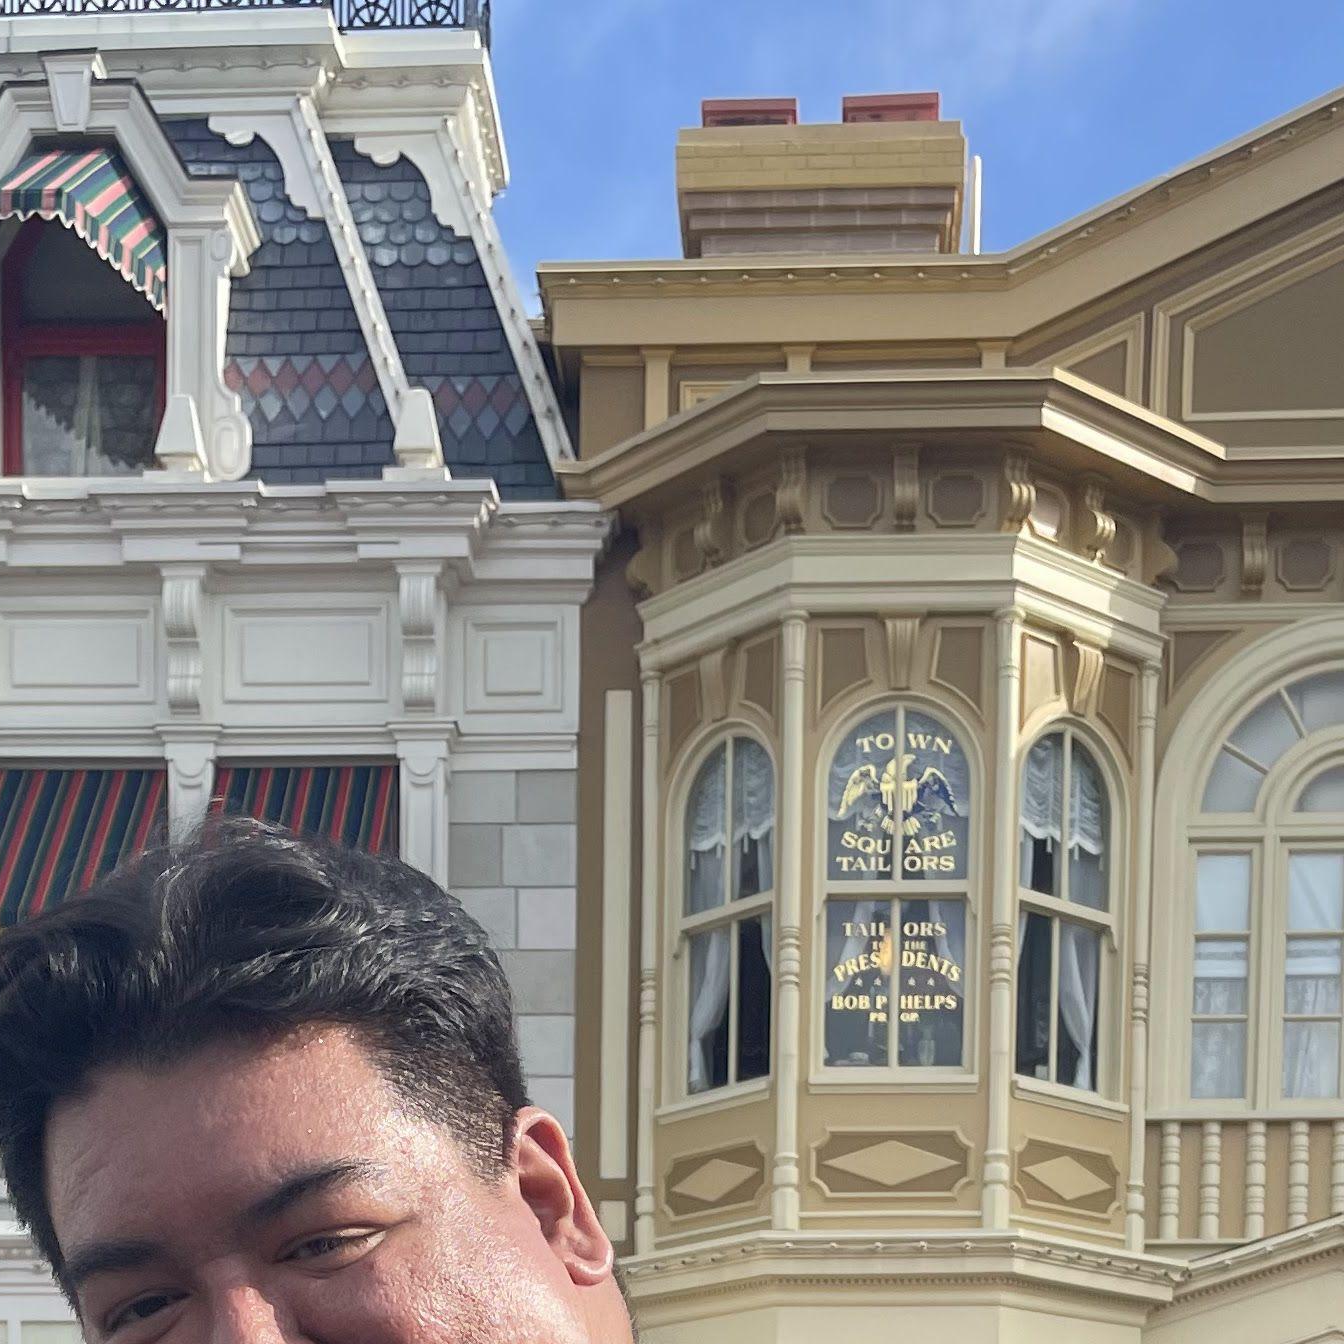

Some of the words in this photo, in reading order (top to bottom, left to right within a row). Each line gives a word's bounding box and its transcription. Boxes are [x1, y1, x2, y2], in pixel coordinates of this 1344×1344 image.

[856, 732, 952, 754] TOWN
[841, 831, 957, 854] SQUARE
[836, 855, 955, 872] TAILORS
[833, 950, 962, 982] PRESDENTS
[832, 995, 871, 1010] BOB
[875, 995, 957, 1010] PHELPS
